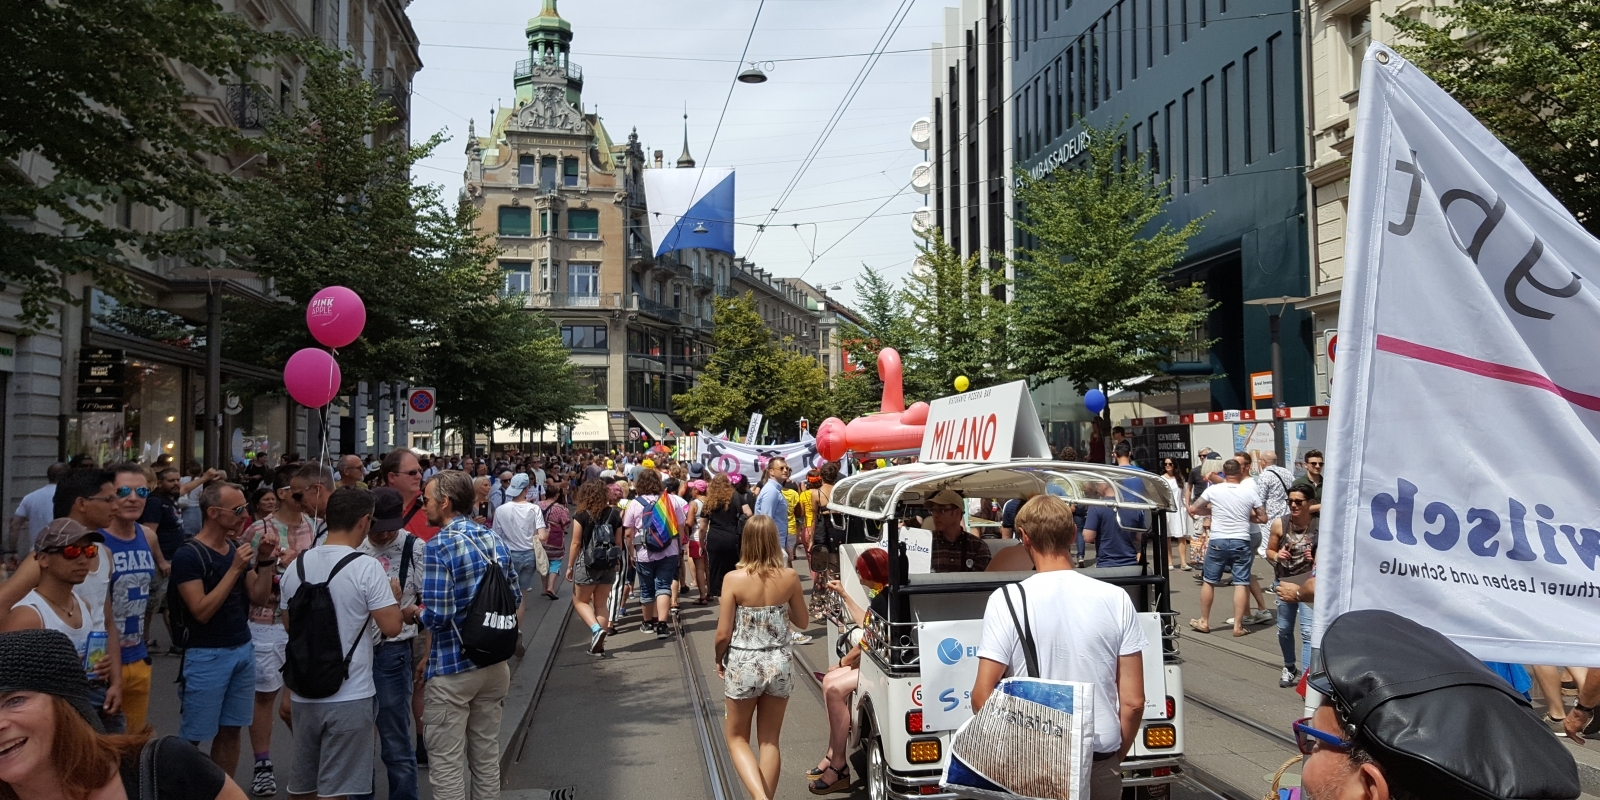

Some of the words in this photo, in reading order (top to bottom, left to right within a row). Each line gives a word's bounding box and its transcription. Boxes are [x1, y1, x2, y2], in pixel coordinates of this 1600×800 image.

[312, 298, 334, 307] PINK
[312, 306, 332, 315] APPLE
[929, 413, 997, 461] MILANO
[573, 442, 593, 450] SALE
[1158, 442, 1172, 450] DURCH
